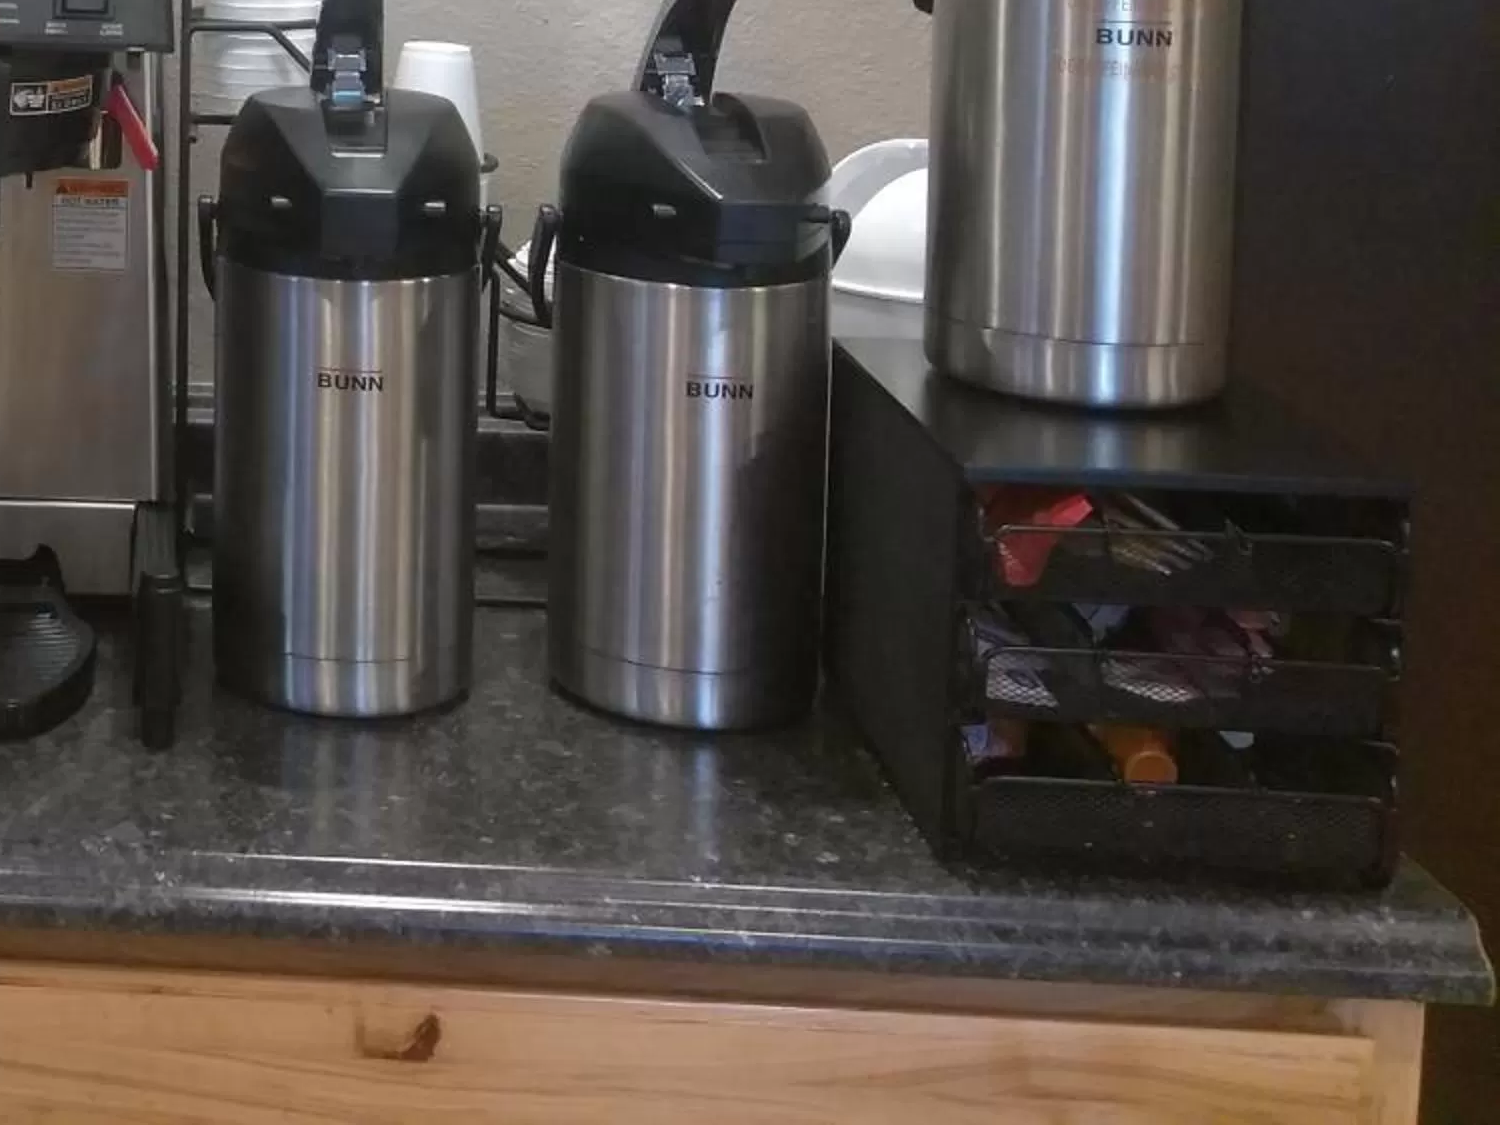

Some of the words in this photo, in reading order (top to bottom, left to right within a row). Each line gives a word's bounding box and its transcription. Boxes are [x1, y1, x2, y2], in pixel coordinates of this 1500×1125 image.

[1095, 27, 1173, 48] BUNN
[317, 373, 385, 392] BUNN
[685, 381, 754, 400] BUNN
